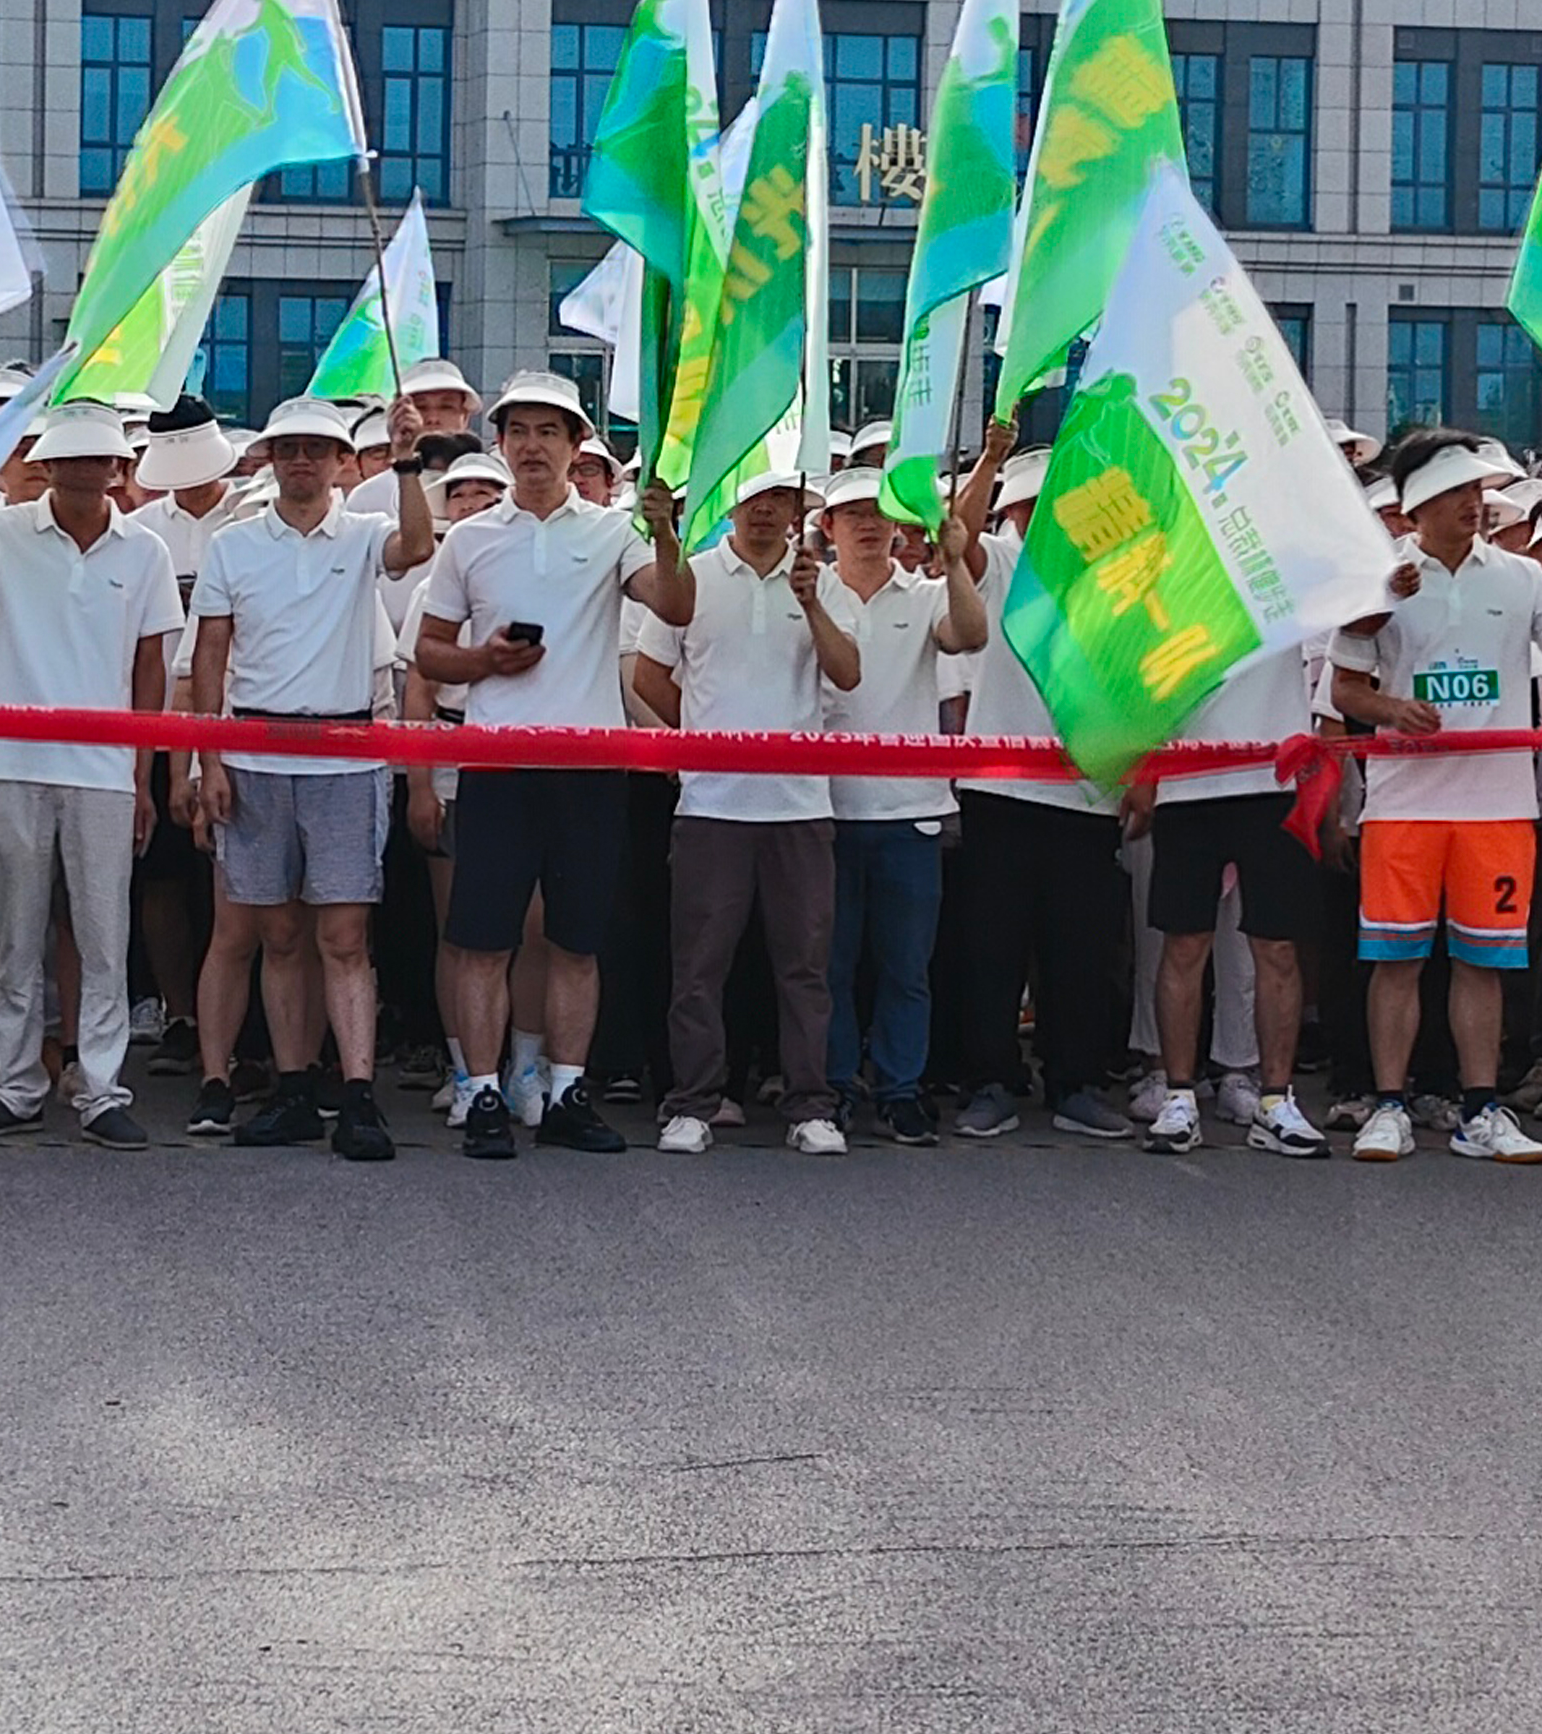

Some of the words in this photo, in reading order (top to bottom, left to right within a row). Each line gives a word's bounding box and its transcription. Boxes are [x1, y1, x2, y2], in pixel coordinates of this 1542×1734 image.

[852, 121, 928, 201] 樓
[1148, 376, 1249, 496] 2024
[1426, 673, 1490, 702] N06
[1494, 876, 1517, 914] 2
